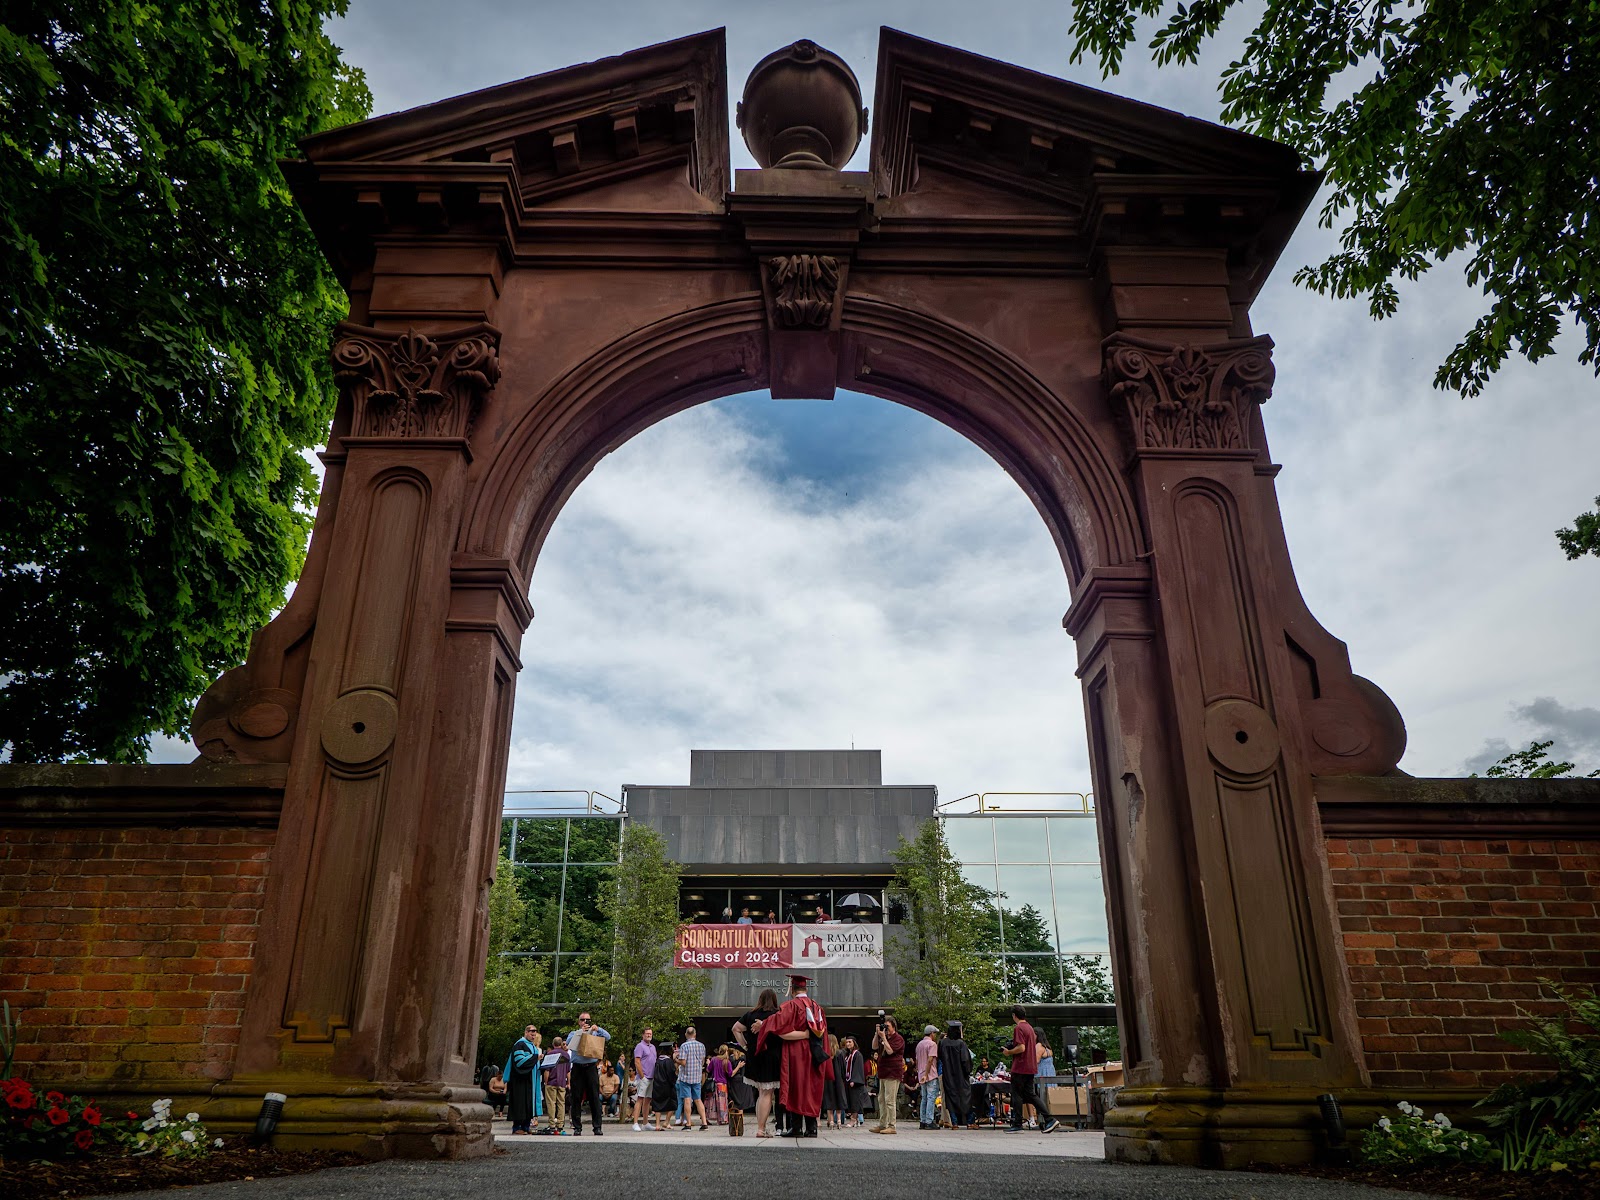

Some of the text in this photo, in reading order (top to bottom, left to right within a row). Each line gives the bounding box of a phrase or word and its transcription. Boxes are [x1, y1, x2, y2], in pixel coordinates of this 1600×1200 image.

[682, 929, 789, 948] CONGRATULATIONS
[827, 934, 874, 942] RAMAPO
[827, 944, 874, 952] COLLEGE
[681, 951, 779, 962] Class of 2024
[739, 979, 819, 987] ACADEMIC CLEX
